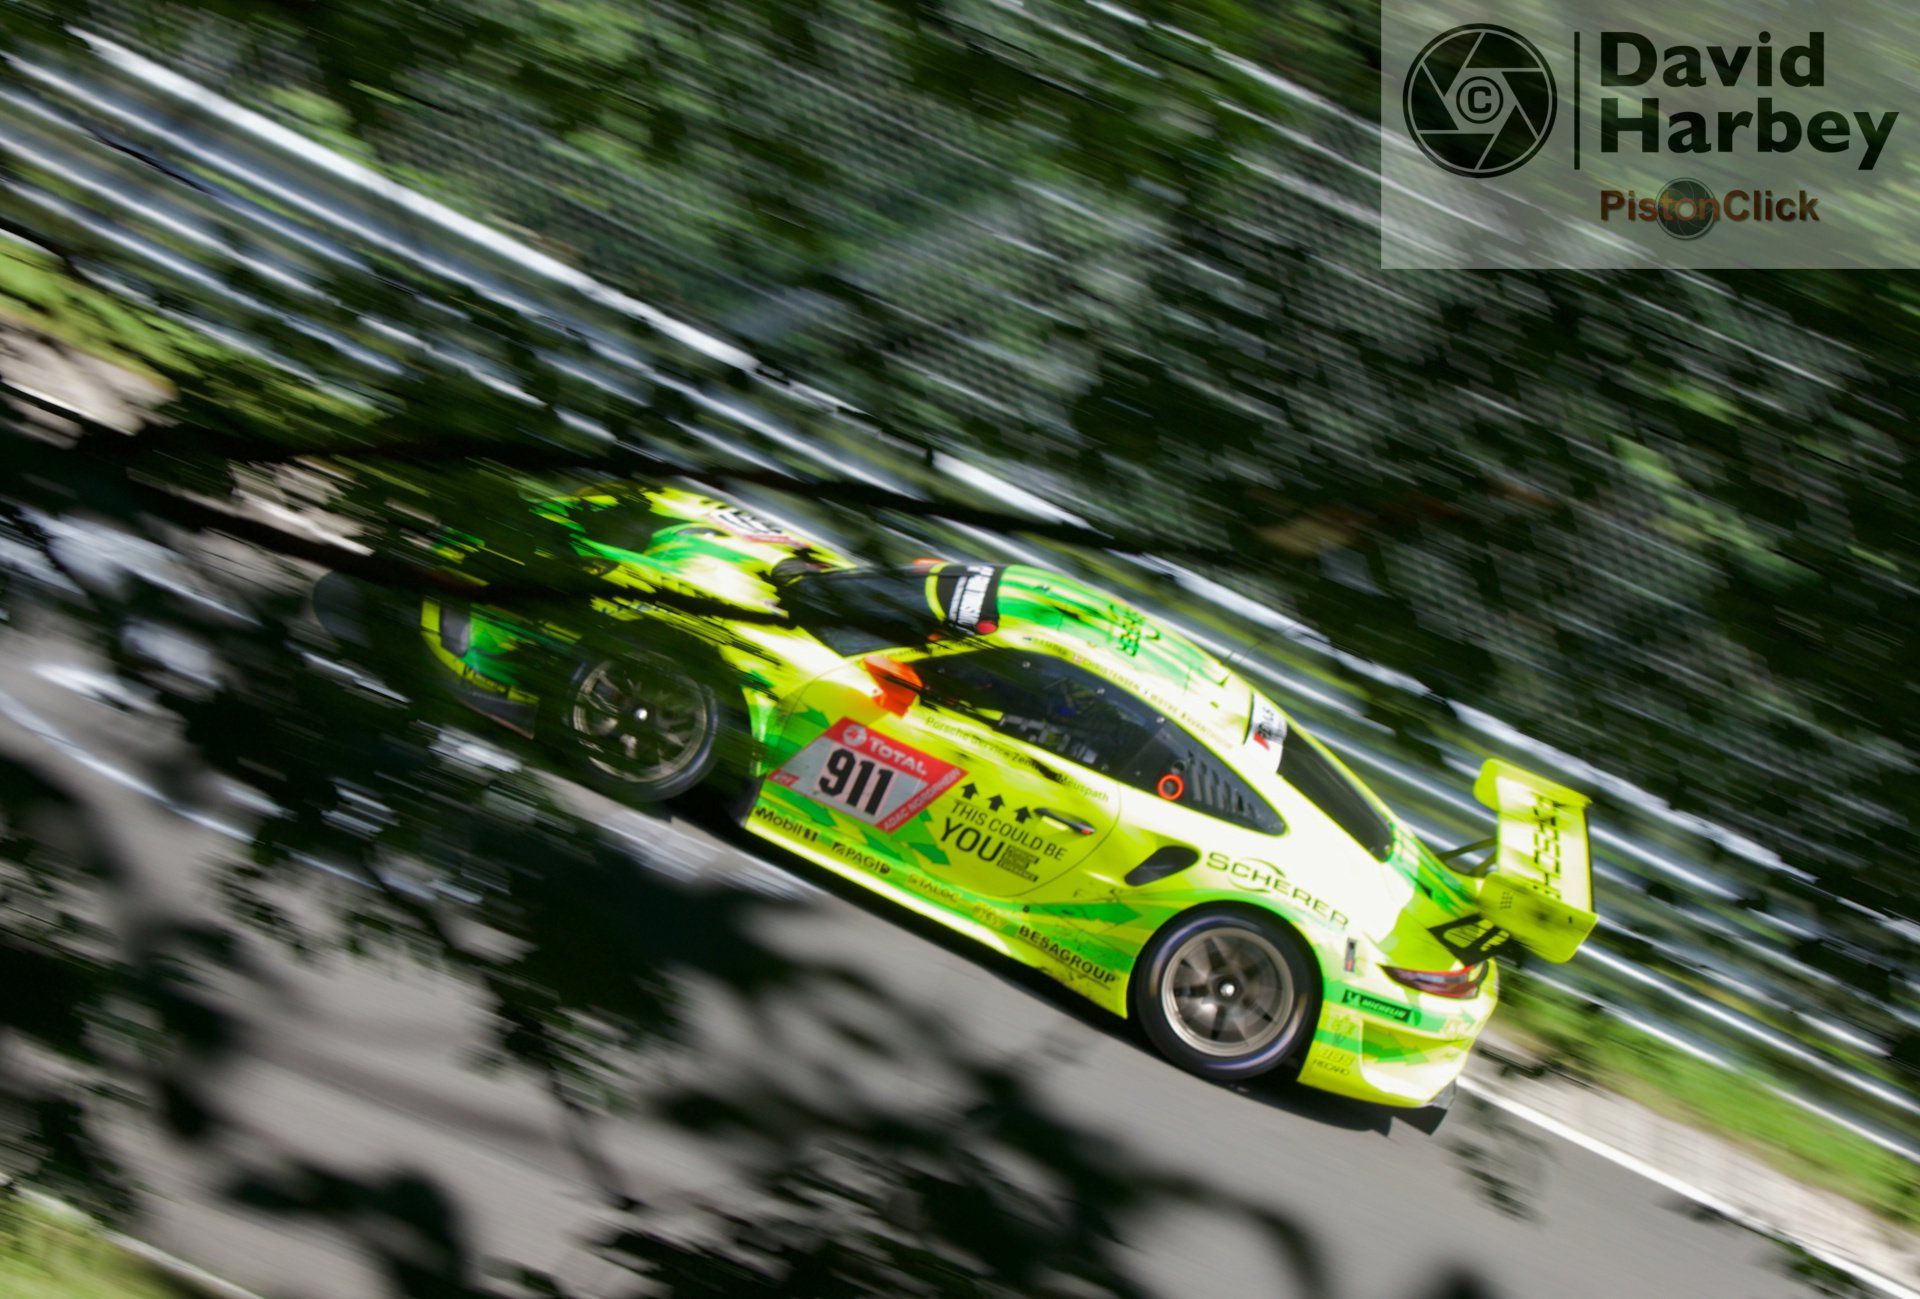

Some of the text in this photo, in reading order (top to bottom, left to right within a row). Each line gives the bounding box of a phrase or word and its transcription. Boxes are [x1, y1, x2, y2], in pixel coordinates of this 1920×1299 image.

[925, 716, 970, 741] Porsche
[869, 736, 928, 775] TOTAL
[819, 748, 894, 816] 911
[754, 807, 802, 835] Mobil
[940, 817, 1005, 862] YOU
[951, 800, 1068, 861] THIS COULD BE
[1206, 852, 1349, 929] SCHERER
[1018, 925, 1117, 984] BESAGROUP
[1360, 998, 1408, 1019] MICHELIN
